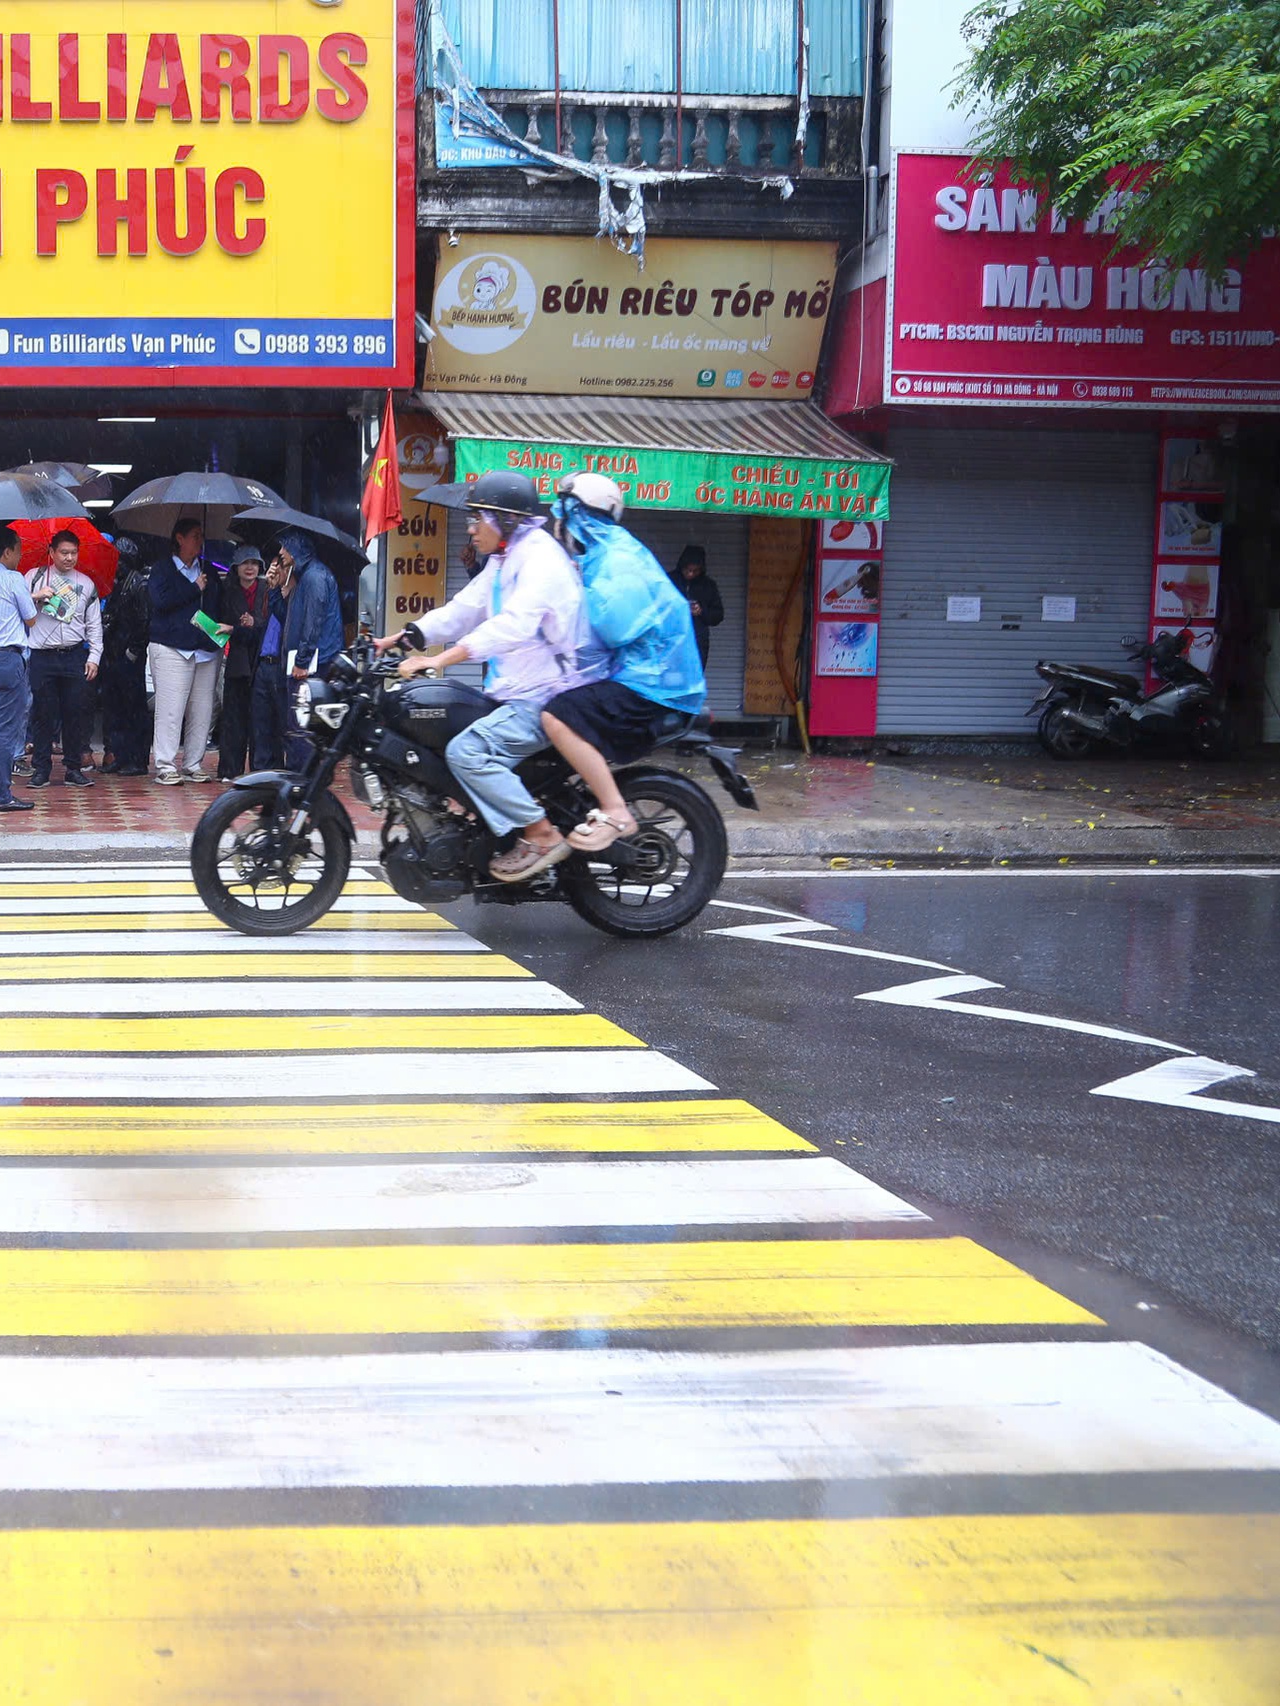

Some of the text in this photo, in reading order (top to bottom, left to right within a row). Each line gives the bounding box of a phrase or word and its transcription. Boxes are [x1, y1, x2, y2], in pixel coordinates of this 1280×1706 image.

[35, 145, 267, 257] PHÚC
[934, 172, 1038, 233] SẢN
[982, 257, 1093, 309] MÀU
[541, 278, 832, 319] BÚN RIÊU TÓP MỠ
[13, 331, 216, 358] Fun Billiards Vạn Phúc
[265, 334, 386, 355] 0988 393 896
[899, 322, 944, 341] PTCM:
[997, 320, 1054, 343] NGUYỄN
[1056, 327, 1102, 346] TRỌNG
[1170, 329, 1205, 346] GPS:
[704, 339, 748, 355] mang
[426, 373, 438, 383] 62
[439, 374, 456, 384] Vạn
[459, 373, 480, 384] Phúc
[489, 374, 501, 384] Hà
[504, 373, 527, 386] Đông
[579, 376, 674, 388] Hotline: 0982.225.256
[932, 382, 946, 394] VẠN
[947, 380, 964, 394] PHÚC
[982, 380, 992, 394] SỐ
[507, 447, 564, 471] SÁNG
[583, 453, 639, 475] TRƯA
[822, 465, 860, 490] TỐI
[636, 479, 672, 502] MỠ
[695, 480, 881, 518] ỐC HÀNG ĂN VẶT
[397, 515, 438, 538] BÚN
[393, 552, 439, 576] RIÊU
[395, 593, 436, 615] BÚN
